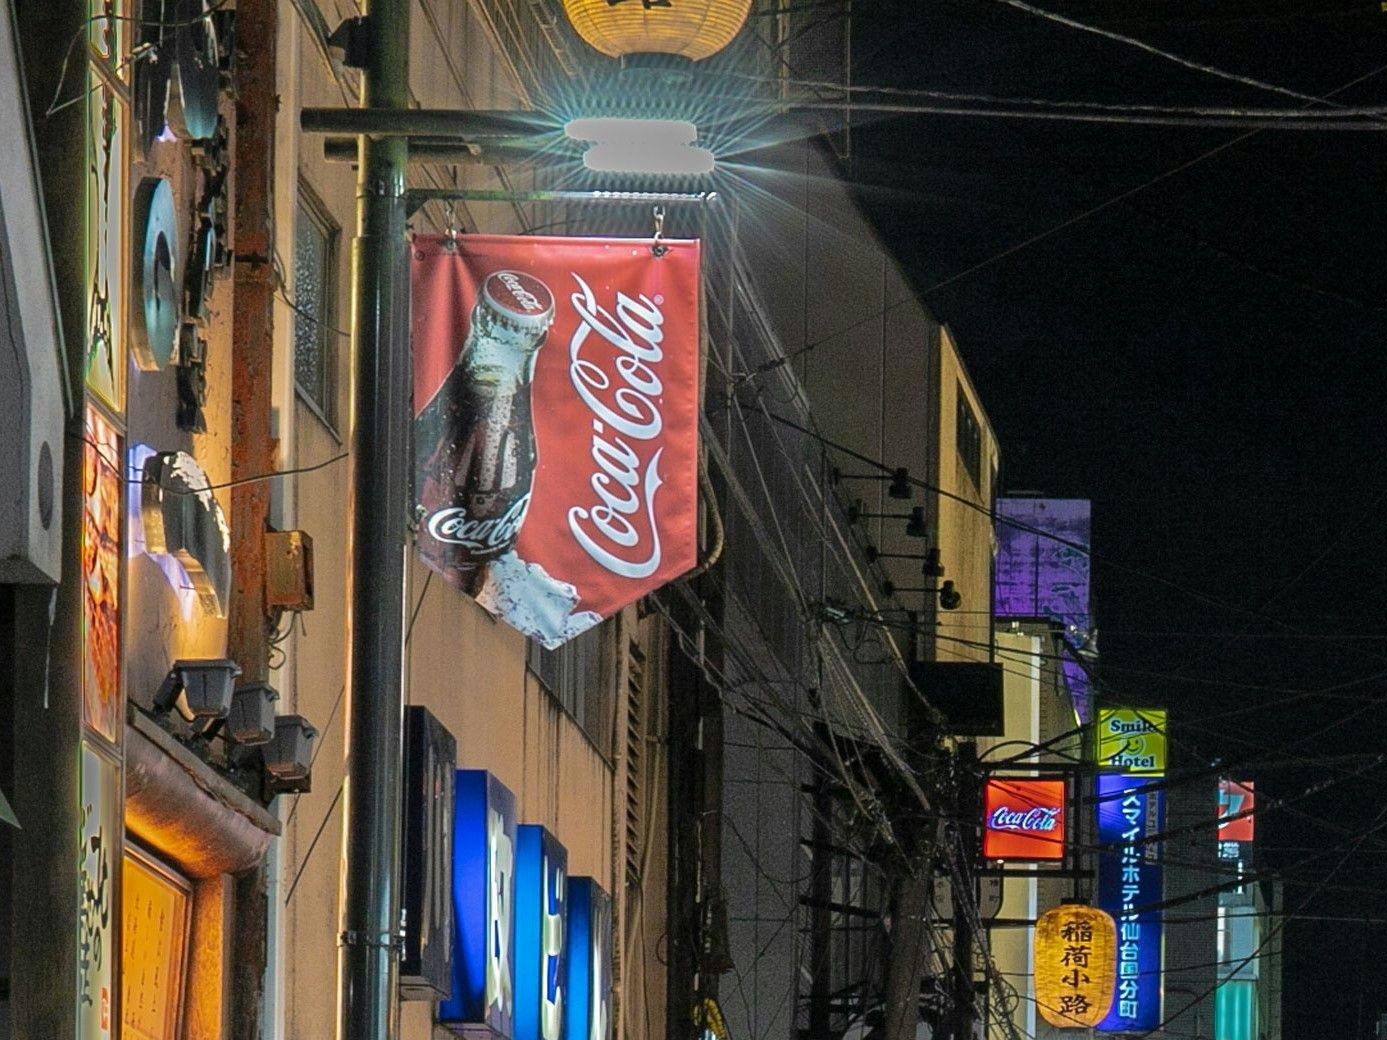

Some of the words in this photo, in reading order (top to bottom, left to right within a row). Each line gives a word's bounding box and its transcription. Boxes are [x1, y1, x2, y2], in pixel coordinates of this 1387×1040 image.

[567, 272, 664, 579] Coca-Cola
[1111, 755, 1155, 769] Hotel
[991, 806, 1061, 832] Coca-Cola
[1060, 920, 1093, 1016] 稲荷小路
